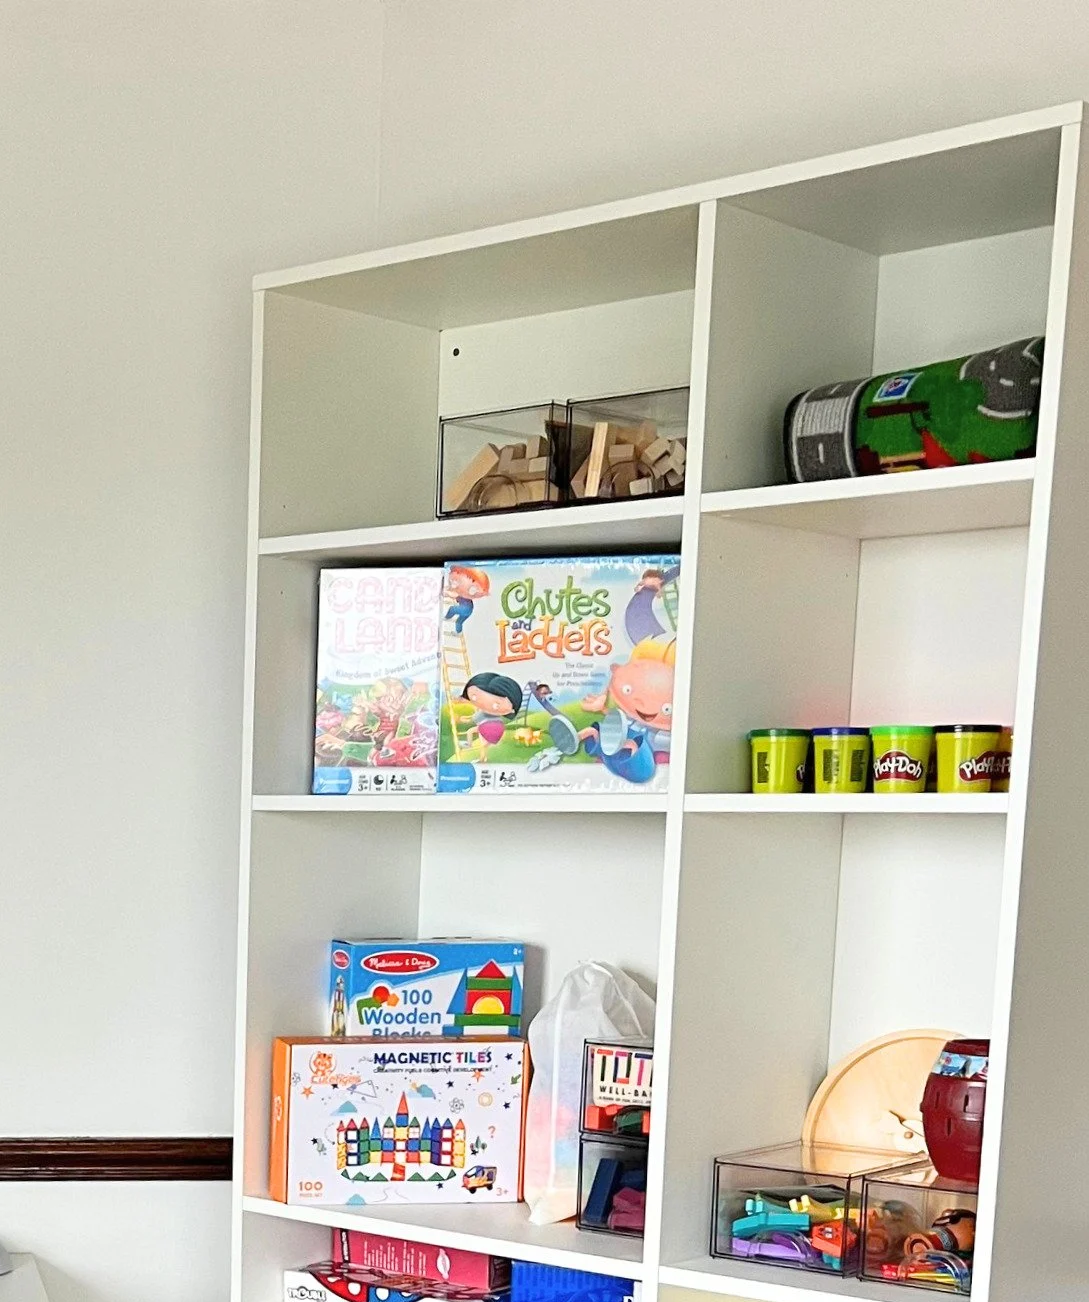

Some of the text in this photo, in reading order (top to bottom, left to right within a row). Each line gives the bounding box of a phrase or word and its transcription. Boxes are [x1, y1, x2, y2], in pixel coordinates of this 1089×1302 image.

[328, 577, 439, 614] CAND
[500, 575, 611, 624] Chutes
[511, 620, 532, 631] and
[334, 617, 438, 653] LAND
[495, 614, 612, 664] Ladders
[873, 756, 922, 779] Play-Doh
[401, 989, 432, 1005] 100
[363, 1007, 442, 1025] Wooden
[373, 1051, 492, 1065] MAGNETIC TILES
[599, 1085, 648, 1098] WELL-BA
[299, 1181, 323, 1191] 100
[496, 1186, 509, 1196] 3+
[287, 1286, 327, 1302] TROUBLE
